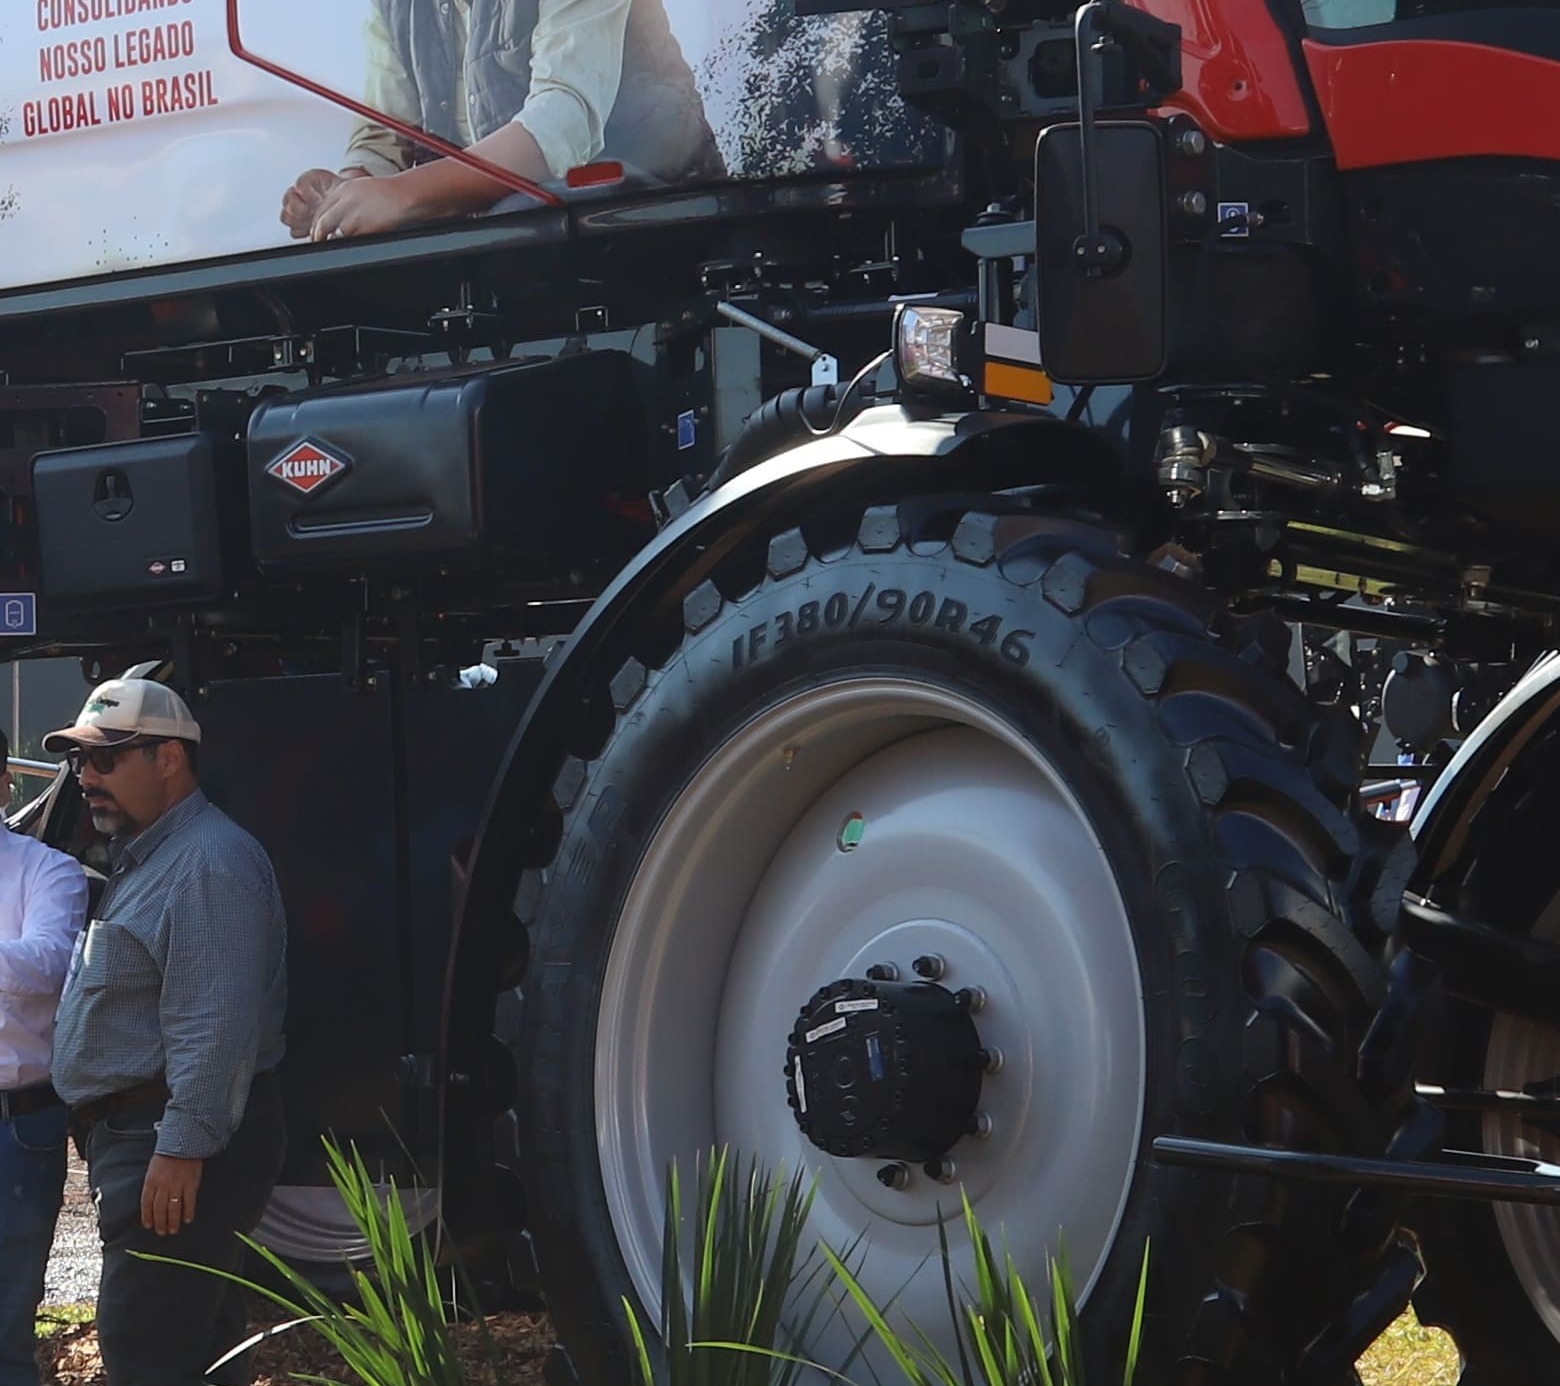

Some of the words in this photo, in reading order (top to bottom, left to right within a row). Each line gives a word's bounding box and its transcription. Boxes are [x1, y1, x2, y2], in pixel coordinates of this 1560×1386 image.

[39, 36, 106, 82] NOSSO
[114, 20, 195, 70] LEGADO
[23, 88, 101, 138] GLOBAL
[107, 87, 136, 122] NO
[142, 69, 219, 118] BRASIL
[281, 457, 332, 479] KUHN
